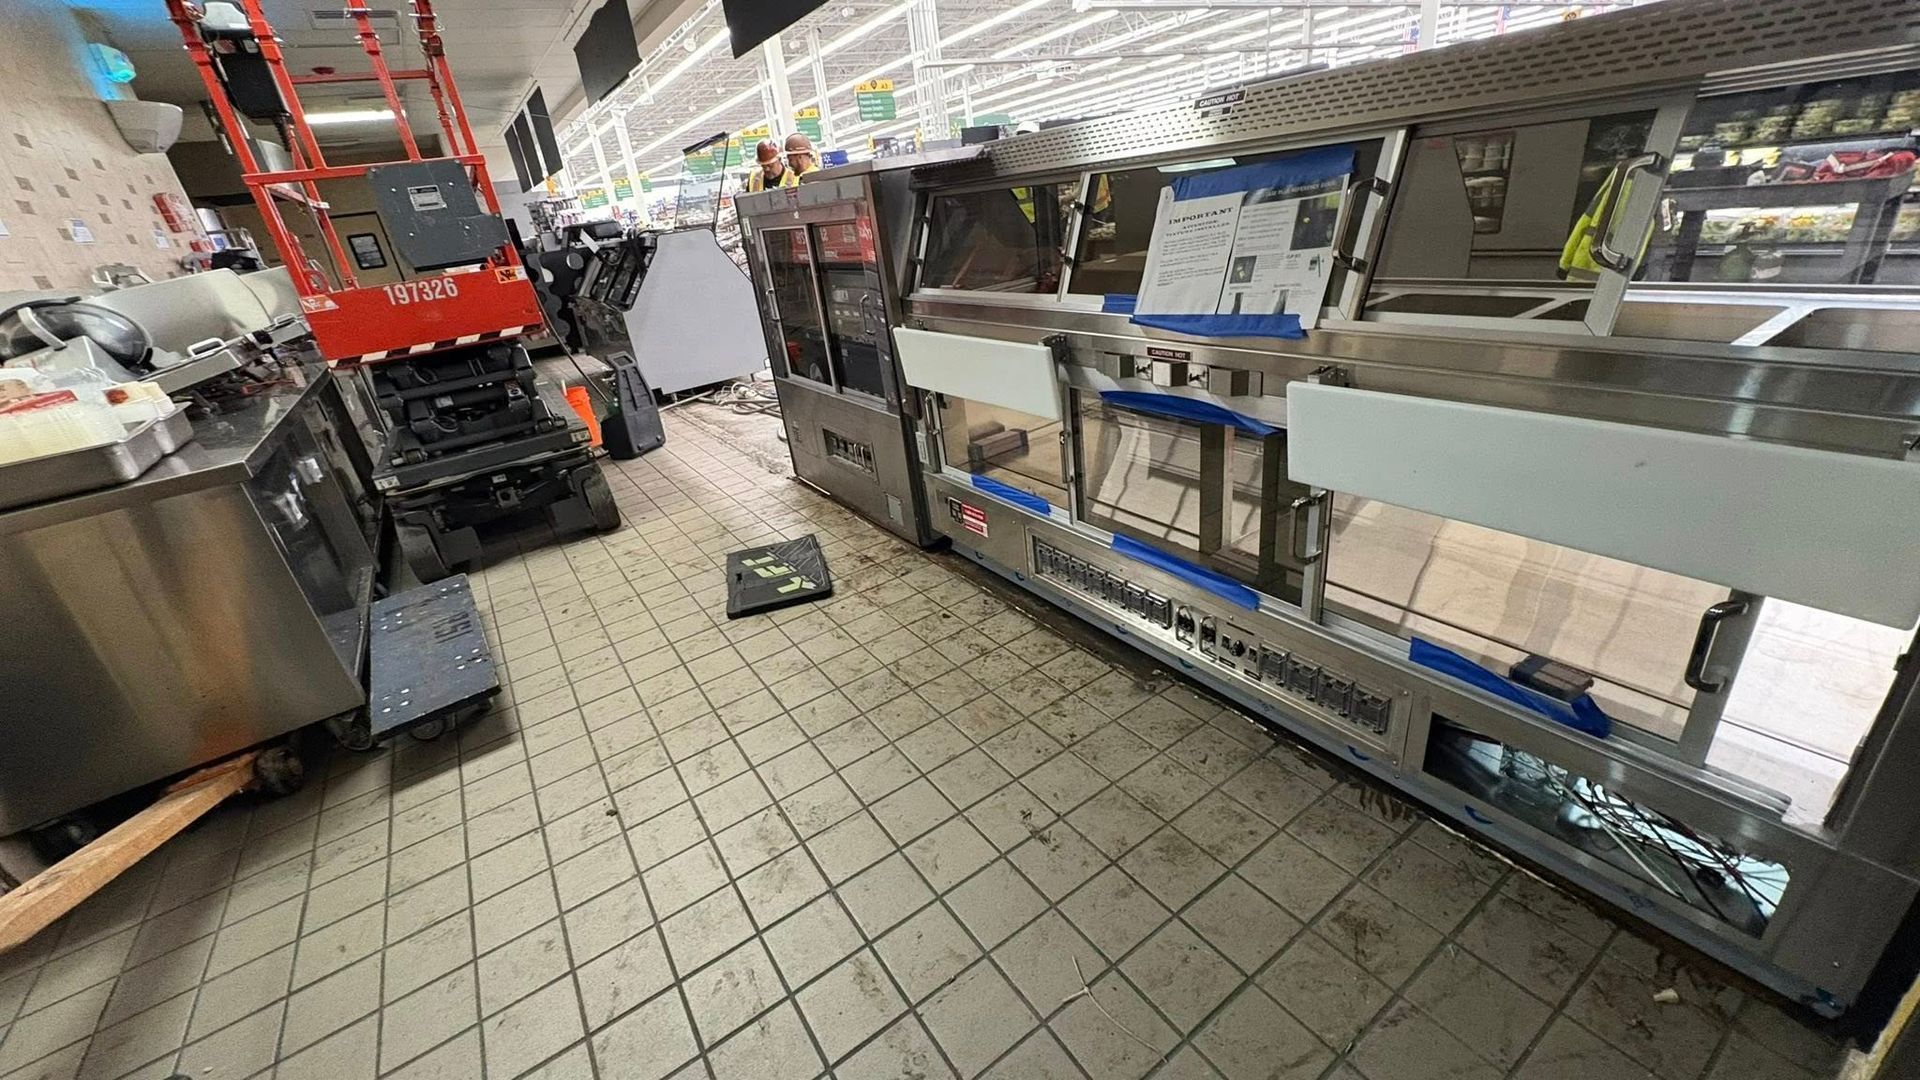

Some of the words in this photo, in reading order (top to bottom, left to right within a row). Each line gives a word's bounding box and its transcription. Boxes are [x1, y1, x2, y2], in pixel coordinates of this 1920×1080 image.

[1199, 96, 1225, 107] CAUTION
[1226, 93, 1240, 102] HOT
[1168, 206, 1234, 225] IMPORTANT
[383, 277, 459, 306] 197326
[1151, 349, 1174, 357] CAUTION
